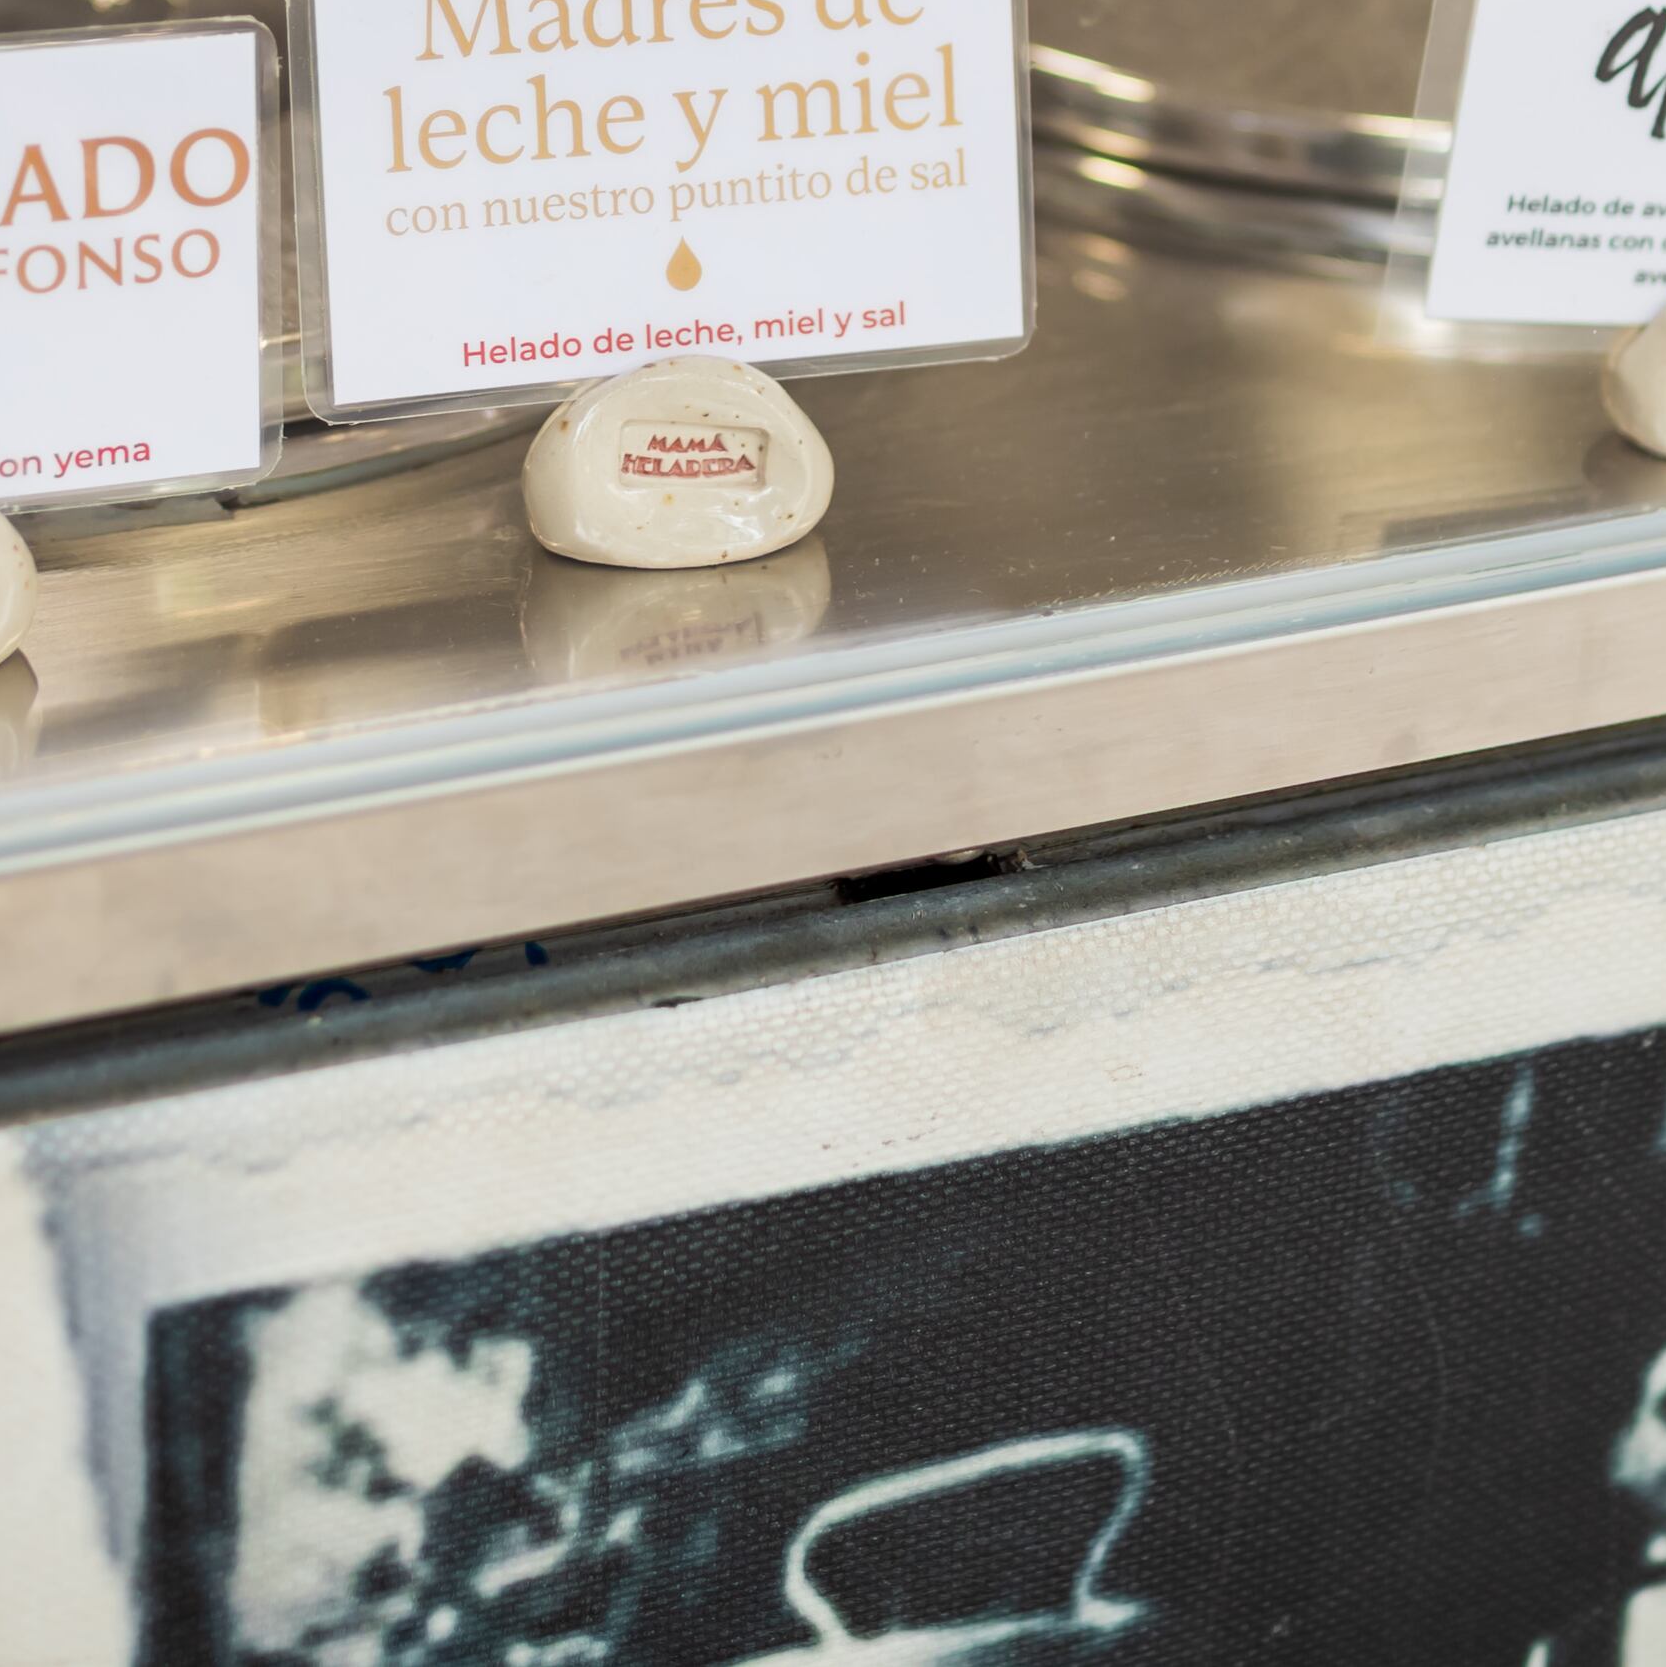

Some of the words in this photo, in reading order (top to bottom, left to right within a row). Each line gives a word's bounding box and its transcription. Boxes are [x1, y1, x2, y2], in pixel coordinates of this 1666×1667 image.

[382, 74, 646, 173] leche
[672, 88, 728, 173] y
[756, 43, 964, 140] miel
[385, 201, 469, 237] con
[482, 177, 655, 229] nuestro
[668, 169, 833, 222] puntito
[844, 154, 898, 196] de
[909, 147, 968, 190] sal
[1506, 194, 1596, 215] Helado
[1603, 198, 1634, 216] de
[1485, 229, 1602, 250] avellanas
[1608, 234, 1654, 251] con
[462, 332, 583, 368] Helado
[592, 326, 635, 356] de
[644, 310, 744, 350] leche,
[754, 308, 825, 337] miel
[833, 311, 854, 339] y
[862, 301, 908, 330] sal
[647, 432, 727, 452] MAMÁ
[55, 440, 151, 478] yema
[620, 453, 756, 478] HELADERA
